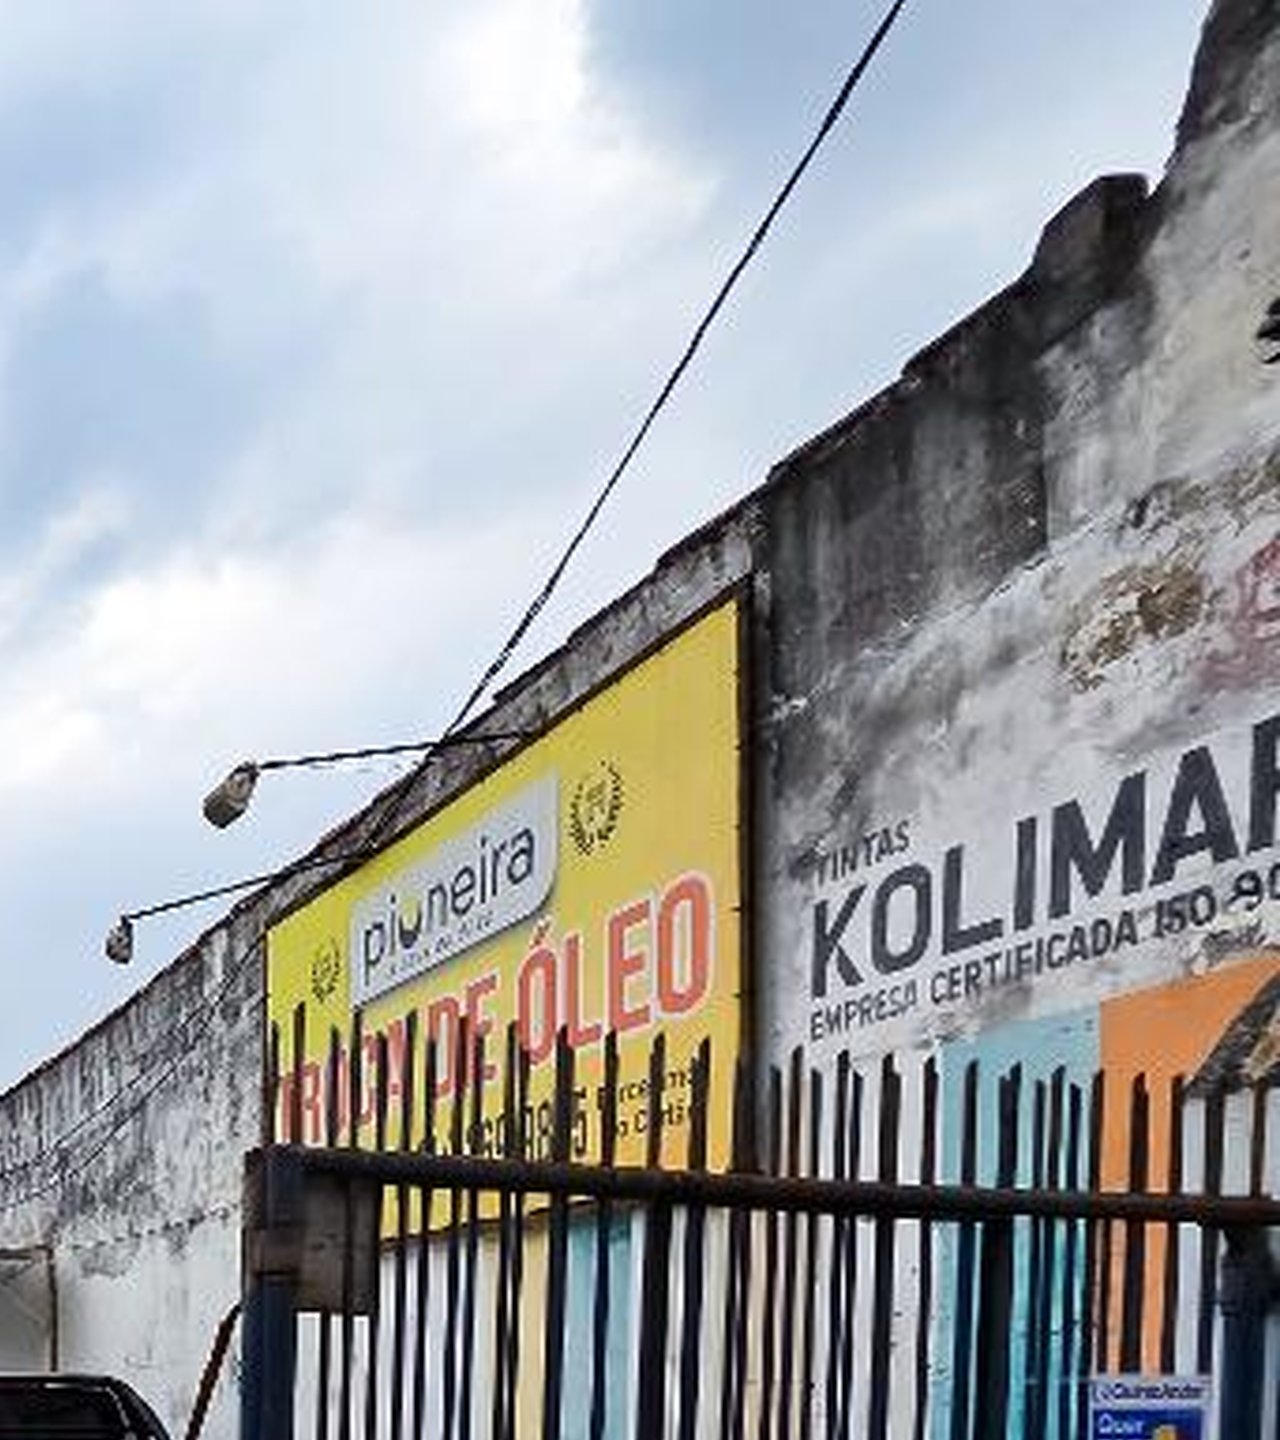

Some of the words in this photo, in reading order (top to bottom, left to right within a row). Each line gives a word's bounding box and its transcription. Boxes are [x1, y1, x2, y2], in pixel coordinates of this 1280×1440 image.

[363, 827, 536, 987] pioneira
[815, 819, 910, 886] TINTAS
[517, 874, 710, 1065] ÓLEO
[811, 987, 918, 1042] EMPRESA
[930, 909, 1140, 1004] CERTIFICADA
